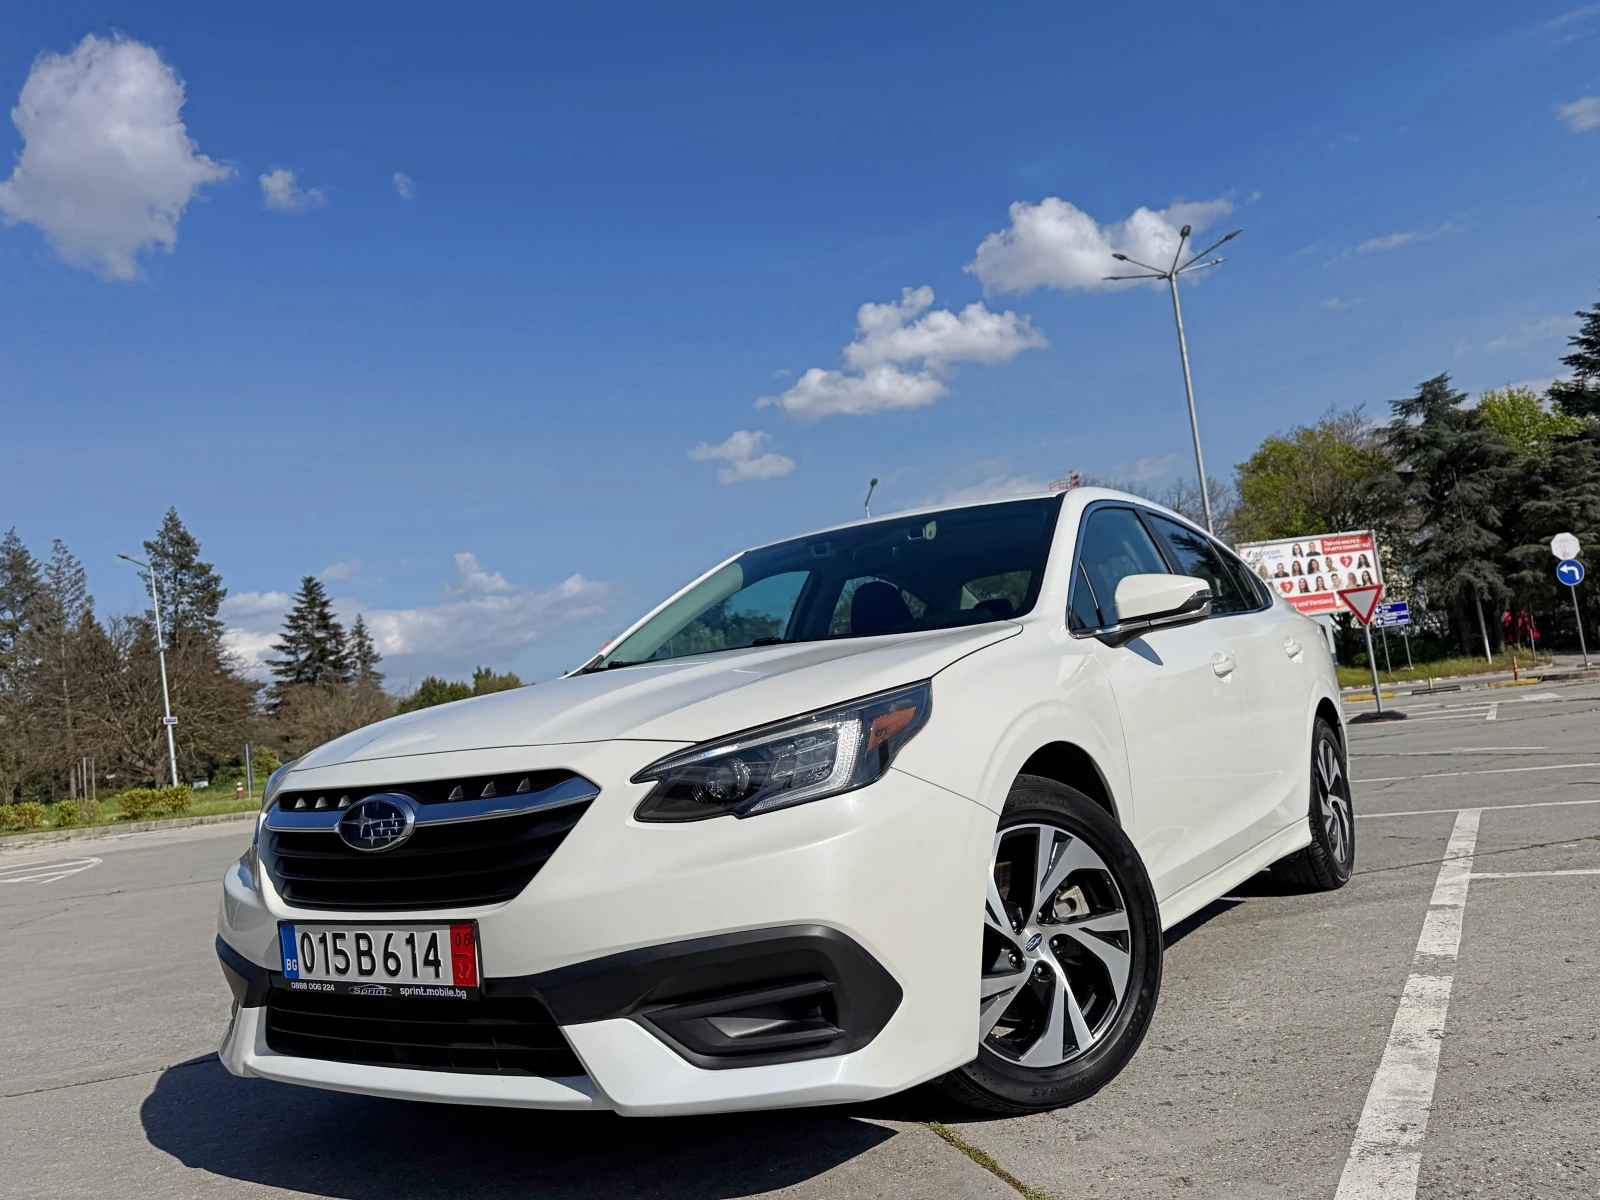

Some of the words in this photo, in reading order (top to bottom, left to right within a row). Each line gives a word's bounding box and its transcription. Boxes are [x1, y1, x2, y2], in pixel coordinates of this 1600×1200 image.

[455, 932, 471, 947] 06
[300, 931, 443, 978] 015B614
[286, 958, 298, 971] BG
[322, 983, 335, 991] 224
[353, 986, 387, 996] Sprint
[399, 986, 467, 999] sprint.mobile.bg
